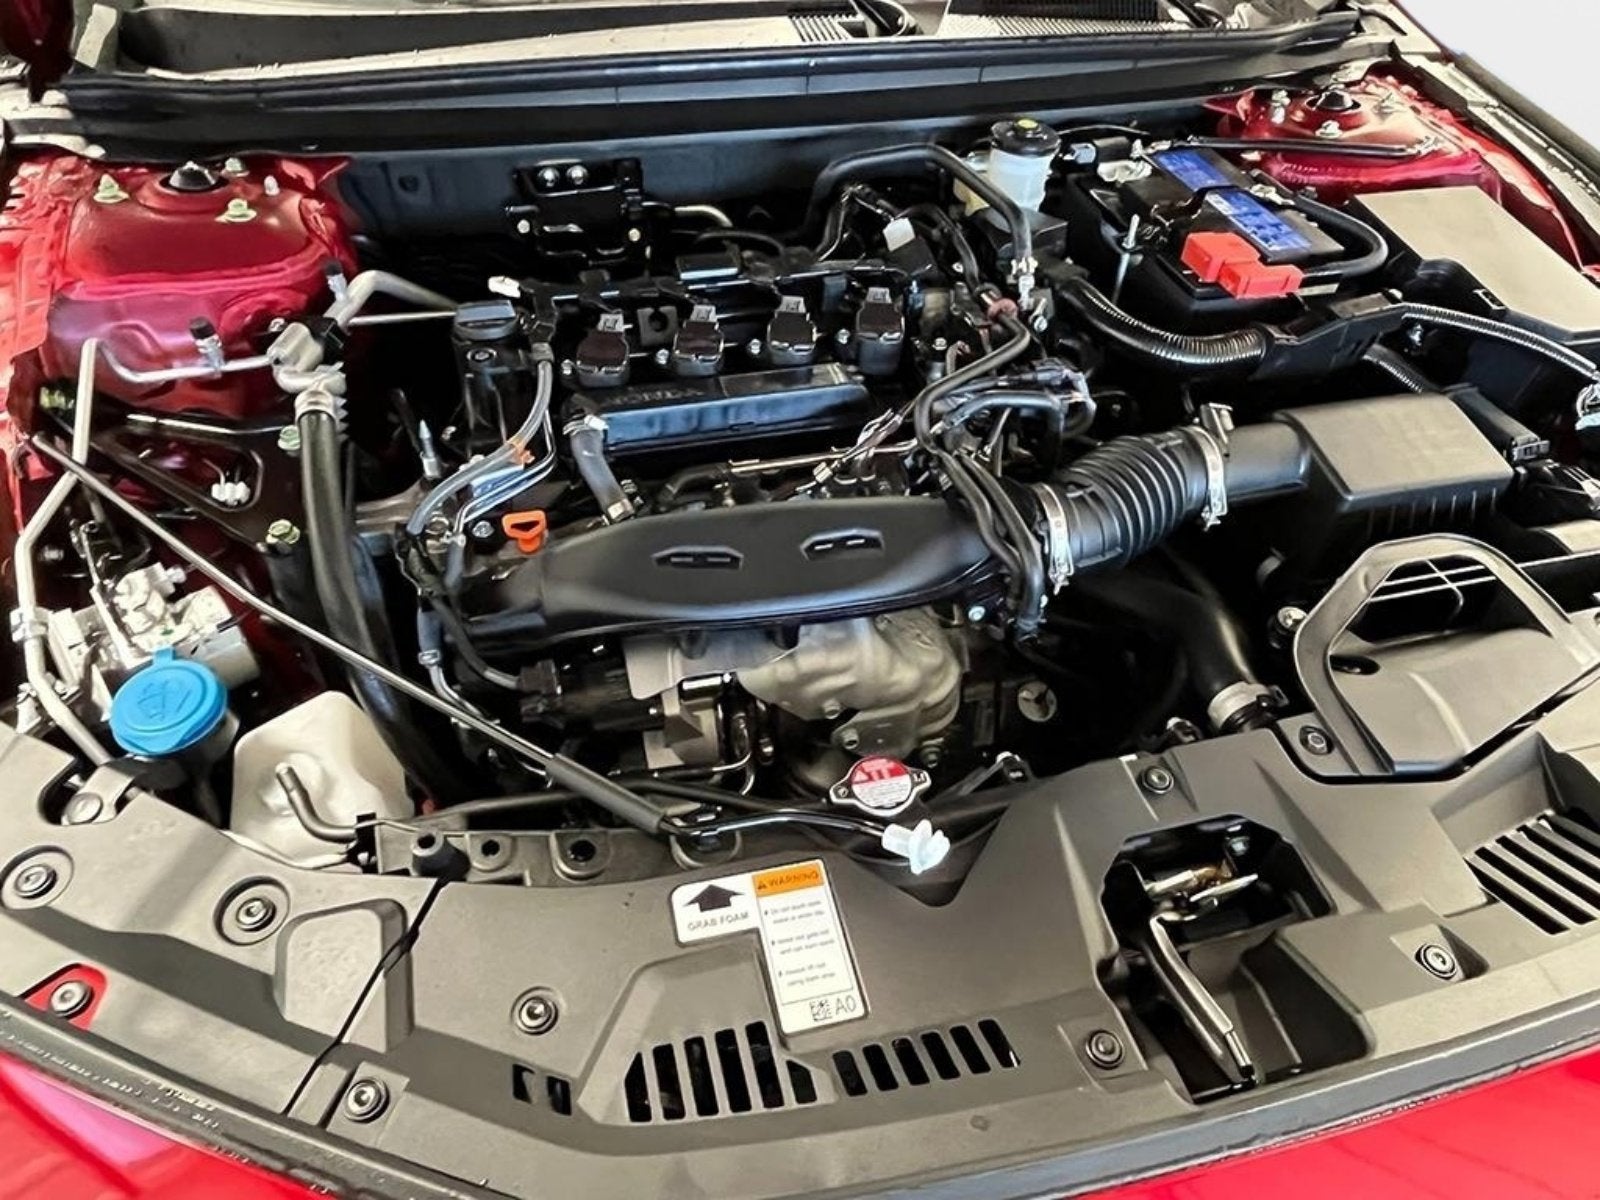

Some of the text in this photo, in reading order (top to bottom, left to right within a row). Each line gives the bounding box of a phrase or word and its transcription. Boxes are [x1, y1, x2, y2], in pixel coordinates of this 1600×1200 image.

[769, 871, 820, 887] WARNING
[687, 911, 749, 932] GRAB FOAM
